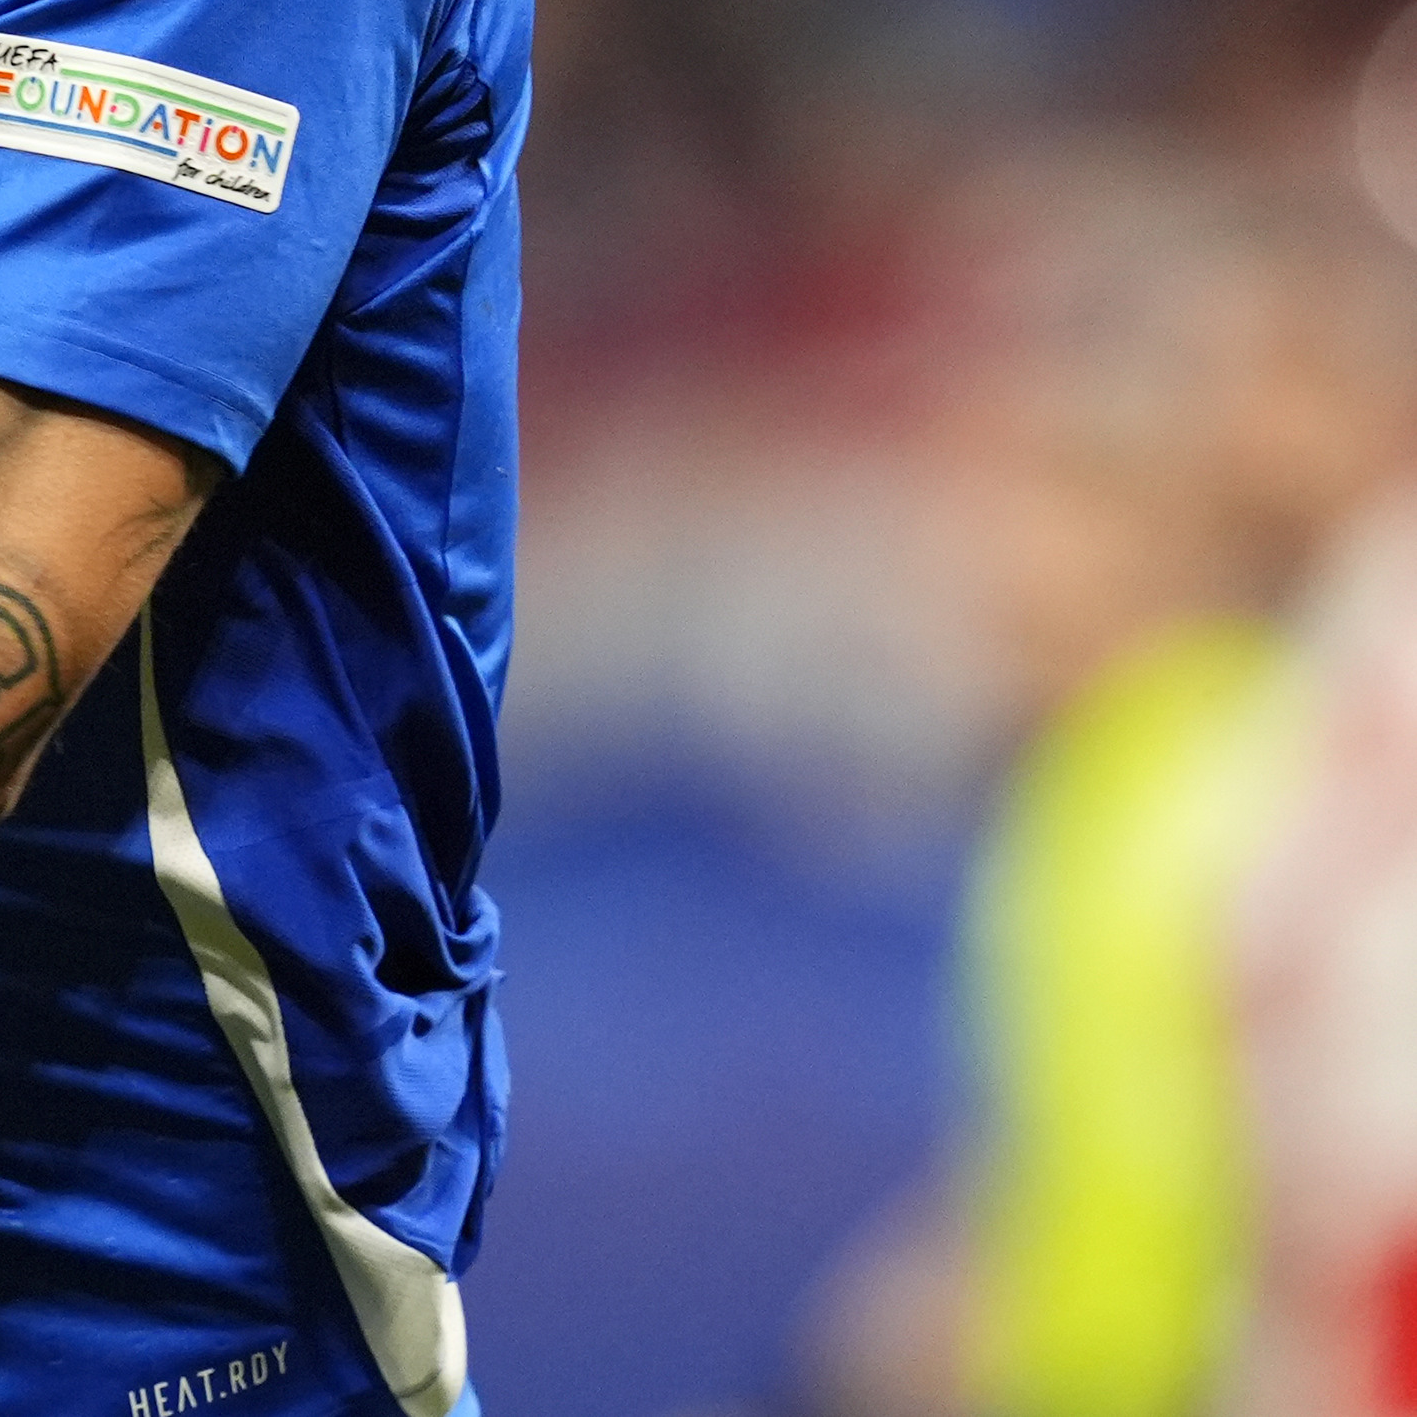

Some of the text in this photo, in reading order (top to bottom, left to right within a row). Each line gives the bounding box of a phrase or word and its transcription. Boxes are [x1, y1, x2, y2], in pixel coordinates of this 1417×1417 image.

[172, 157, 271, 203] for children
[128, 1340, 289, 1417] HEAT.RDY
